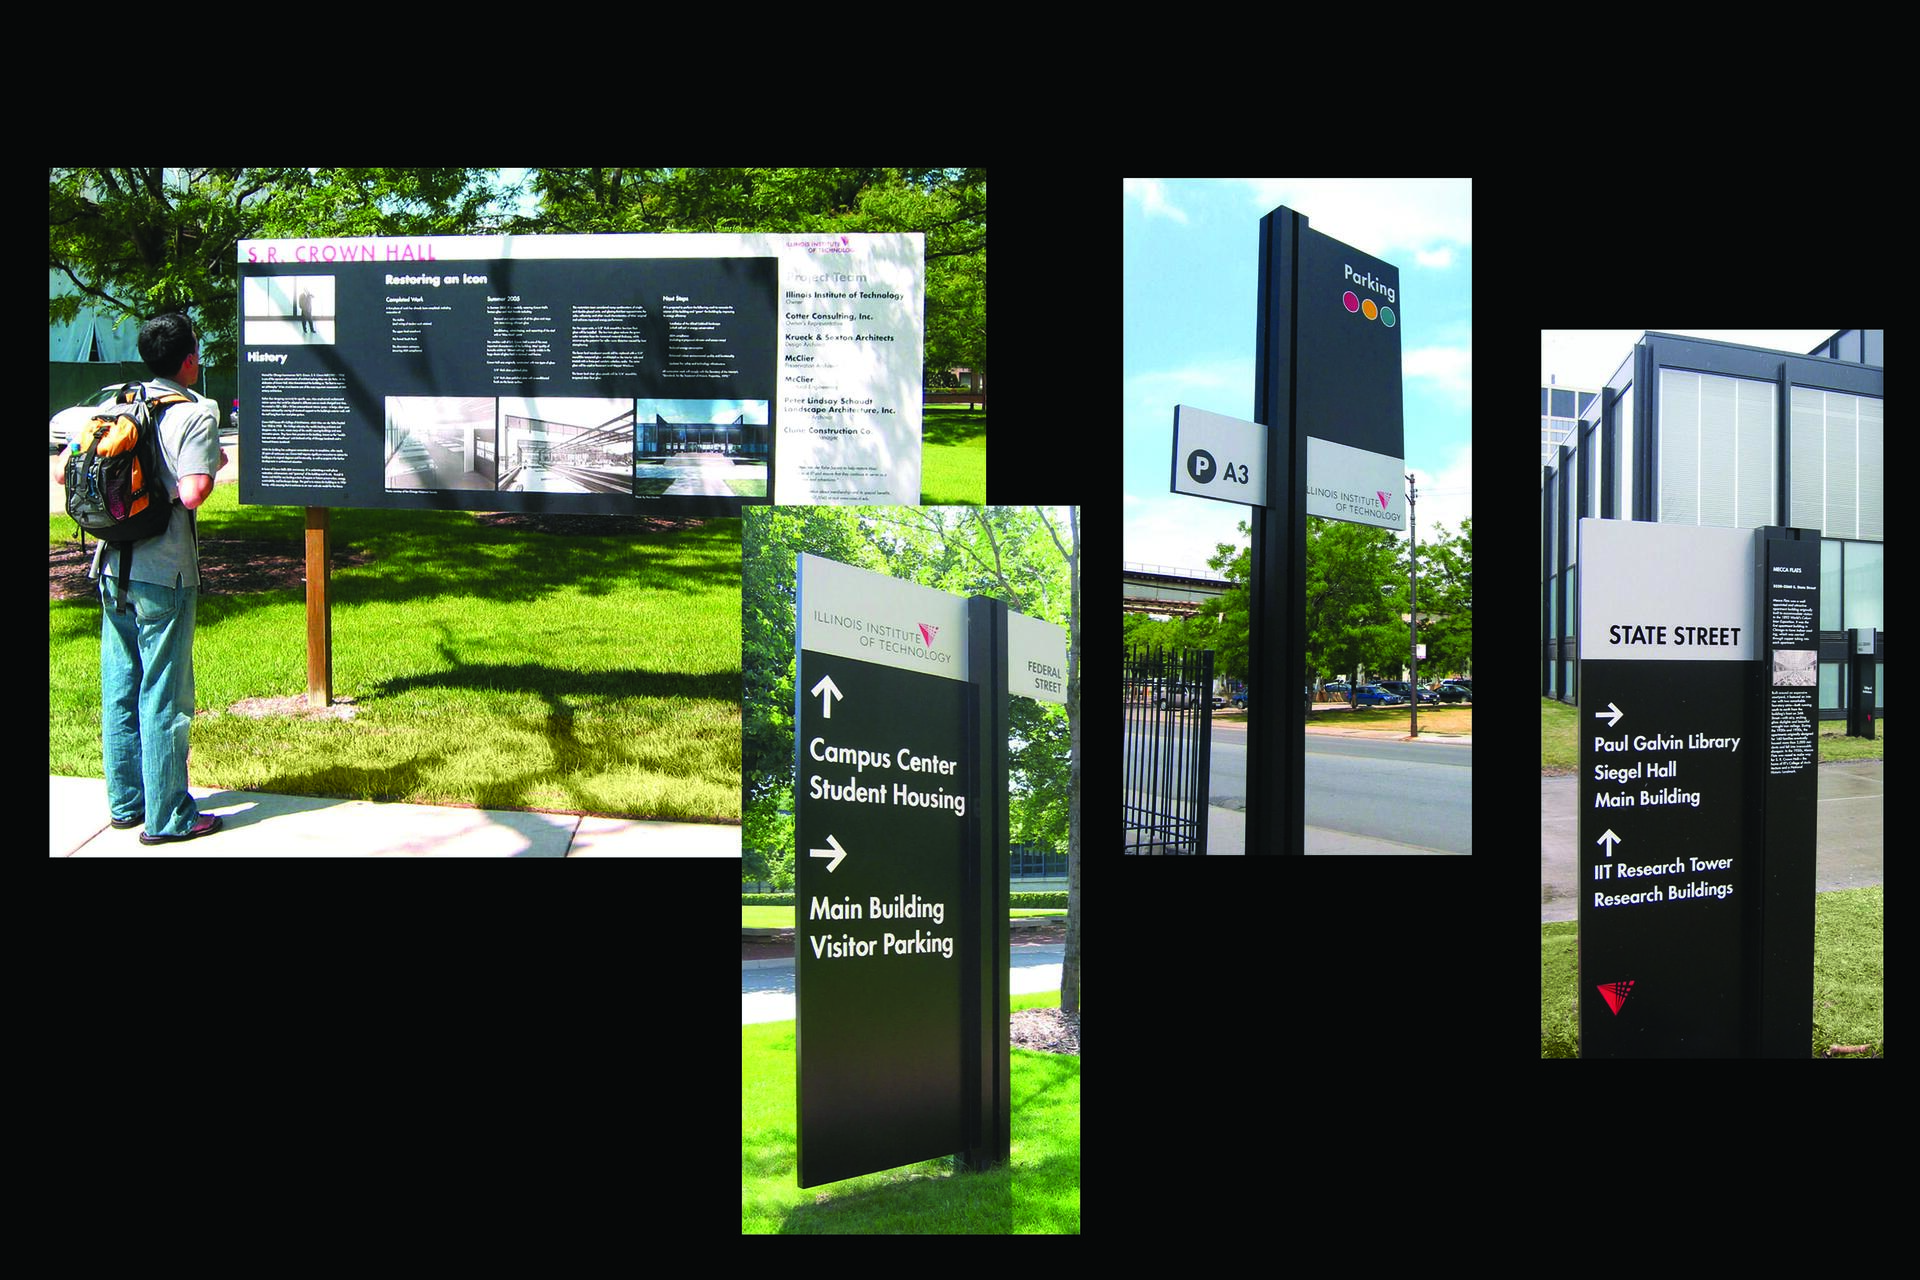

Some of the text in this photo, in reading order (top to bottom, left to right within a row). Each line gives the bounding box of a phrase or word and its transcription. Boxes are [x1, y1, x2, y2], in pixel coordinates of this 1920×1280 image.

[248, 244, 436, 264] S.R. CROWN HALL
[385, 274, 487, 287] Restoring an Icon
[833, 272, 866, 282] Team
[1344, 264, 1396, 303] Parking
[860, 292, 903, 300] Technology
[812, 312, 856, 321] Consulting,
[247, 351, 288, 364] History
[808, 397, 838, 406] Lindsay
[1223, 462, 1249, 485] A3
[1307, 486, 1379, 508] LLINOIS INSTITUTE
[1336, 503, 1401, 521] OF TECHNOLOGY
[814, 610, 921, 645] ILLINOIS INSTITUTE
[1610, 625, 1741, 646] STATE STREET
[859, 635, 952, 665] OF TECHNOLOGY
[1027, 660, 1062, 680] FEDERAL
[1034, 677, 1062, 694] STREET
[1594, 733, 1741, 754] Paul Galvin Library
[810, 737, 957, 776] Campus Center
[1594, 761, 1677, 783] Siegel Hall
[810, 776, 966, 816] Student Housing
[1594, 787, 1700, 809] Main Building
[1594, 856, 1733, 881] IIT Research Tower
[1594, 882, 1733, 908] Research Buildings
[810, 894, 945, 924] Main Building
[810, 930, 954, 960] Visitor Parking
